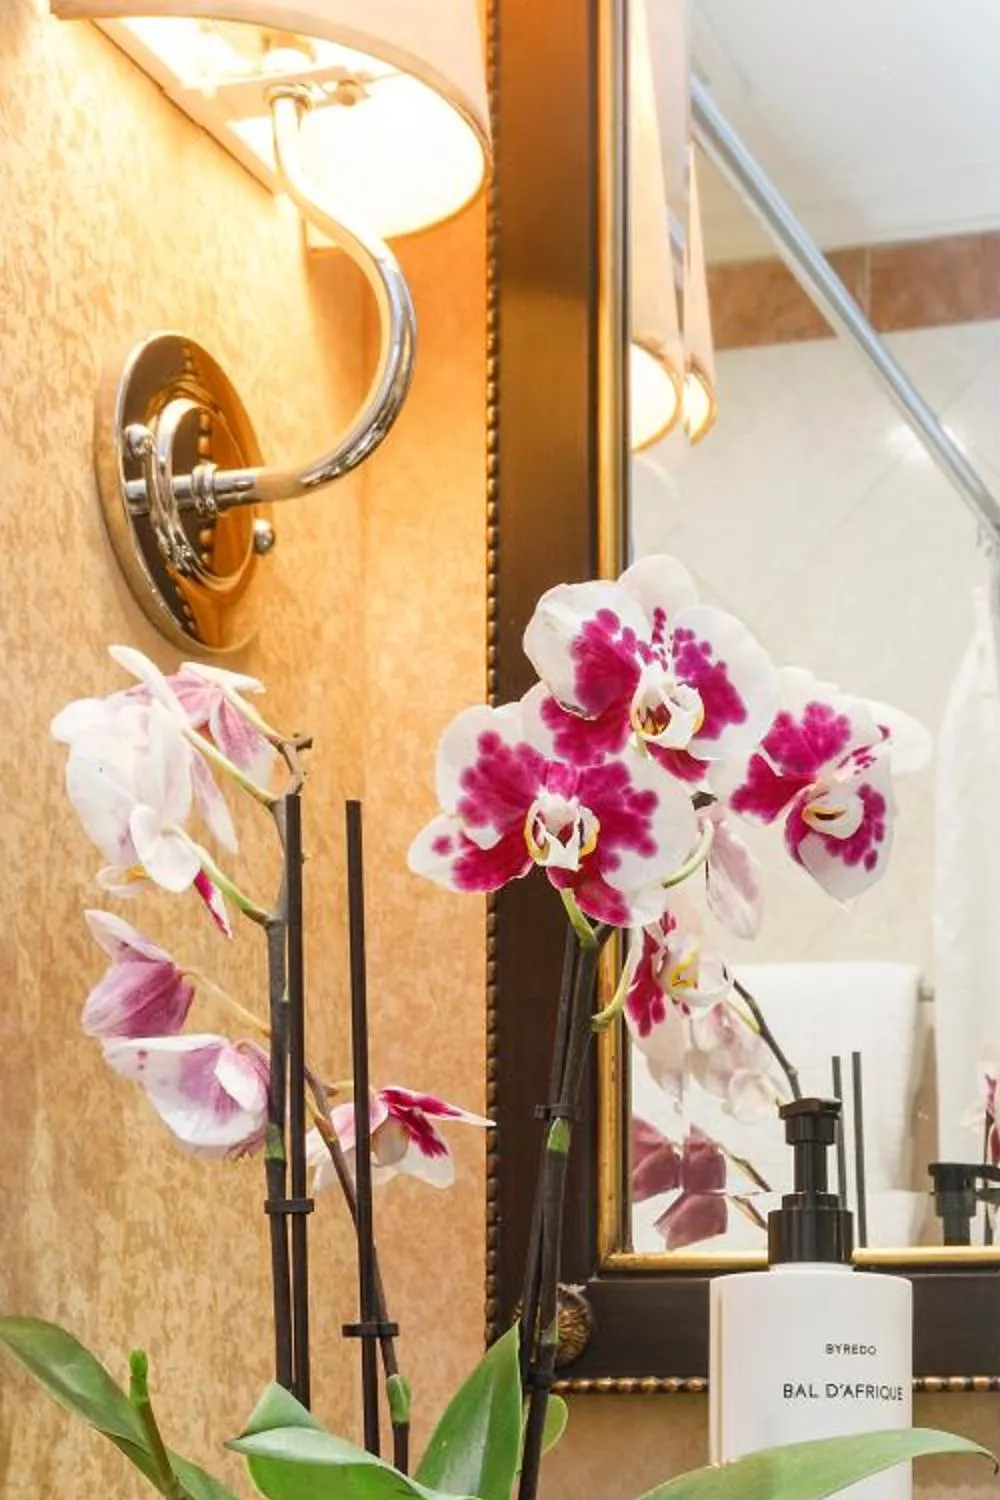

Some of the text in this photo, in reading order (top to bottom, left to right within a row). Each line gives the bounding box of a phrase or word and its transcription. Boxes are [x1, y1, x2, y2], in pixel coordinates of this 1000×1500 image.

[826, 1343, 877, 1355] BYREDO
[783, 1383, 904, 1401] BAL D'AFRIQUE
